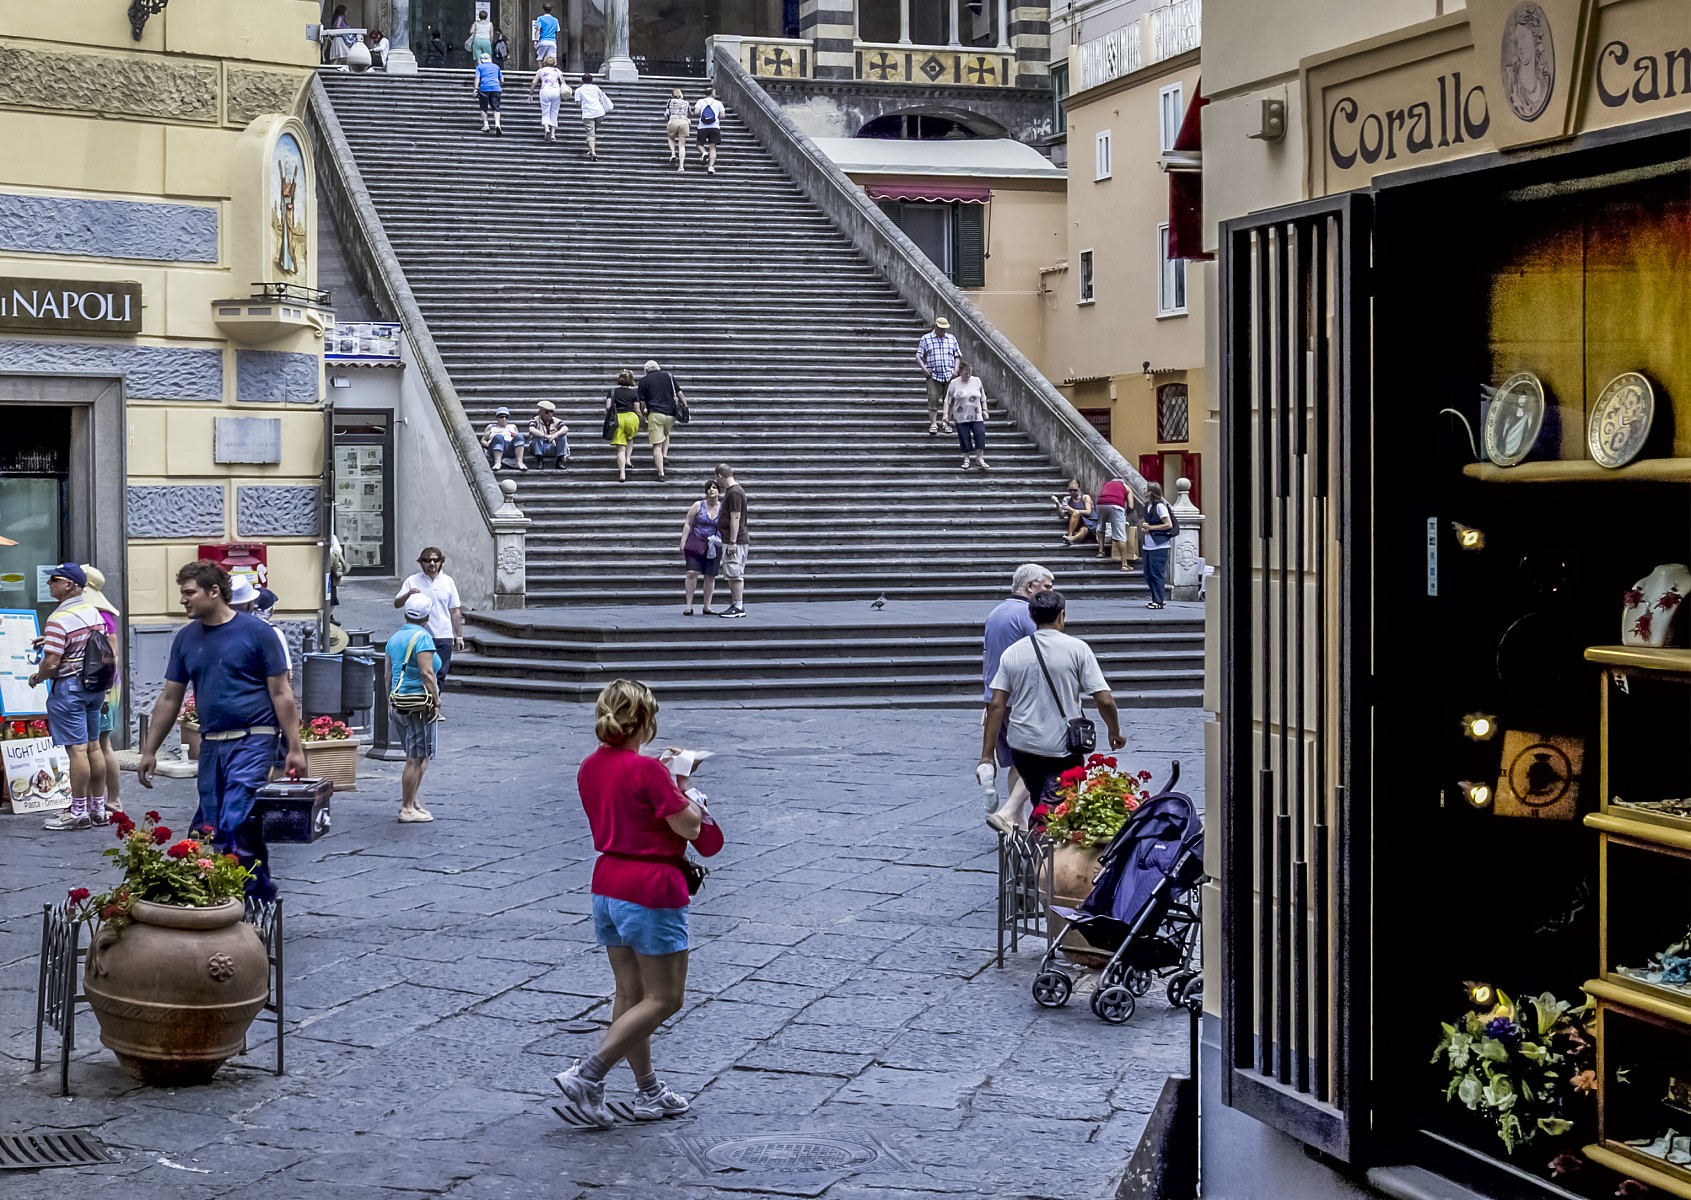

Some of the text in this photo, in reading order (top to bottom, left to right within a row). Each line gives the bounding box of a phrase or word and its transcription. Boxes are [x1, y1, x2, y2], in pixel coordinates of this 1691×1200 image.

[1329, 71, 1490, 170] Corallo
[12, 288, 132, 321] NAPOLI
[6, 744, 34, 759] LIGHT
[24, 801, 41, 809] Pasta
